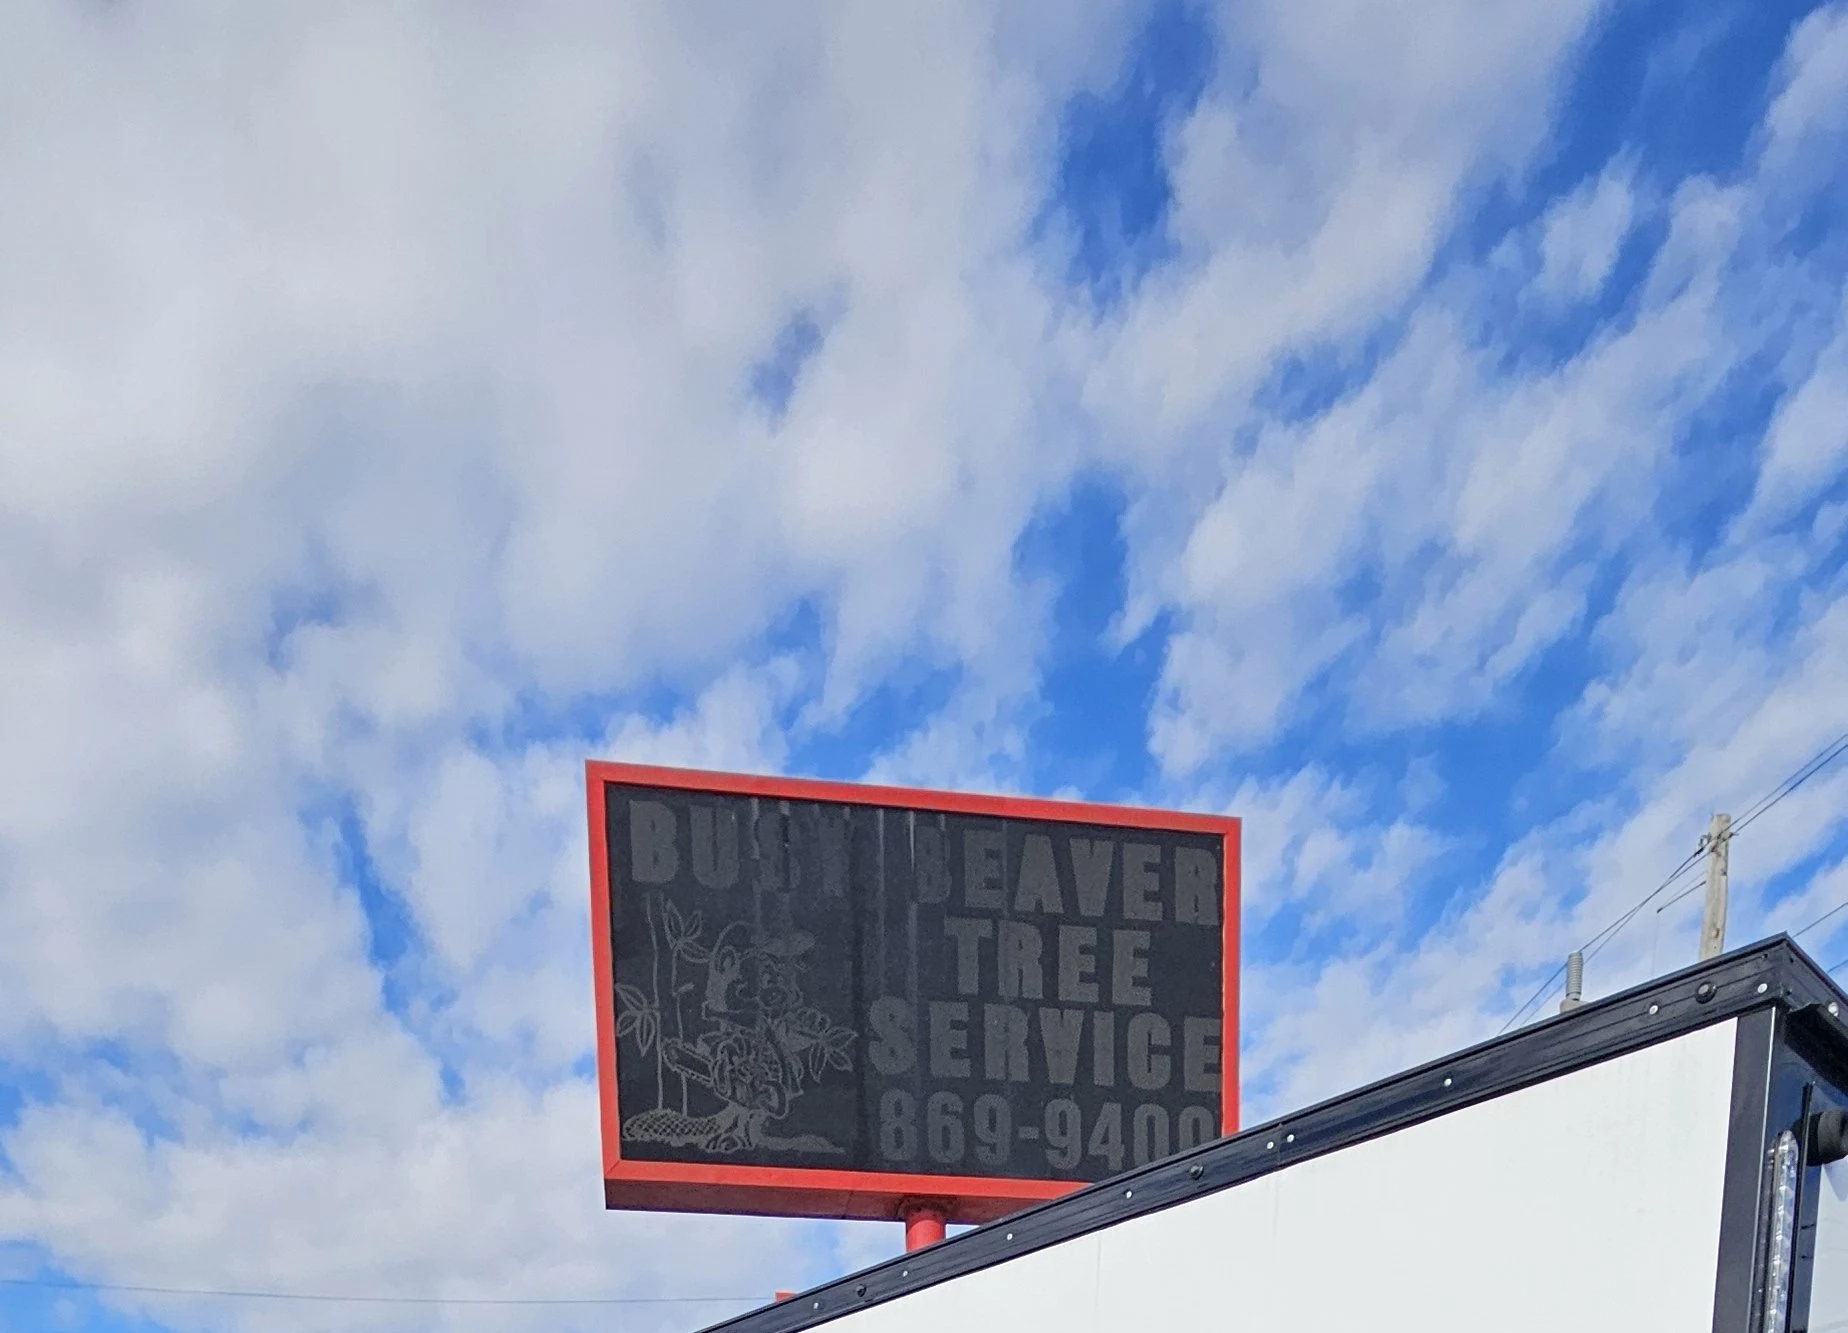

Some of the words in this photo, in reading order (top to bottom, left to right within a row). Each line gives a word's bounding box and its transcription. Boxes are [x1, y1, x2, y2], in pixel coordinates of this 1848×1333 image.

[915, 824, 1218, 925] BEAVER
[943, 915, 1152, 1006] TREE
[867, 997, 1221, 1092] SERVICE
